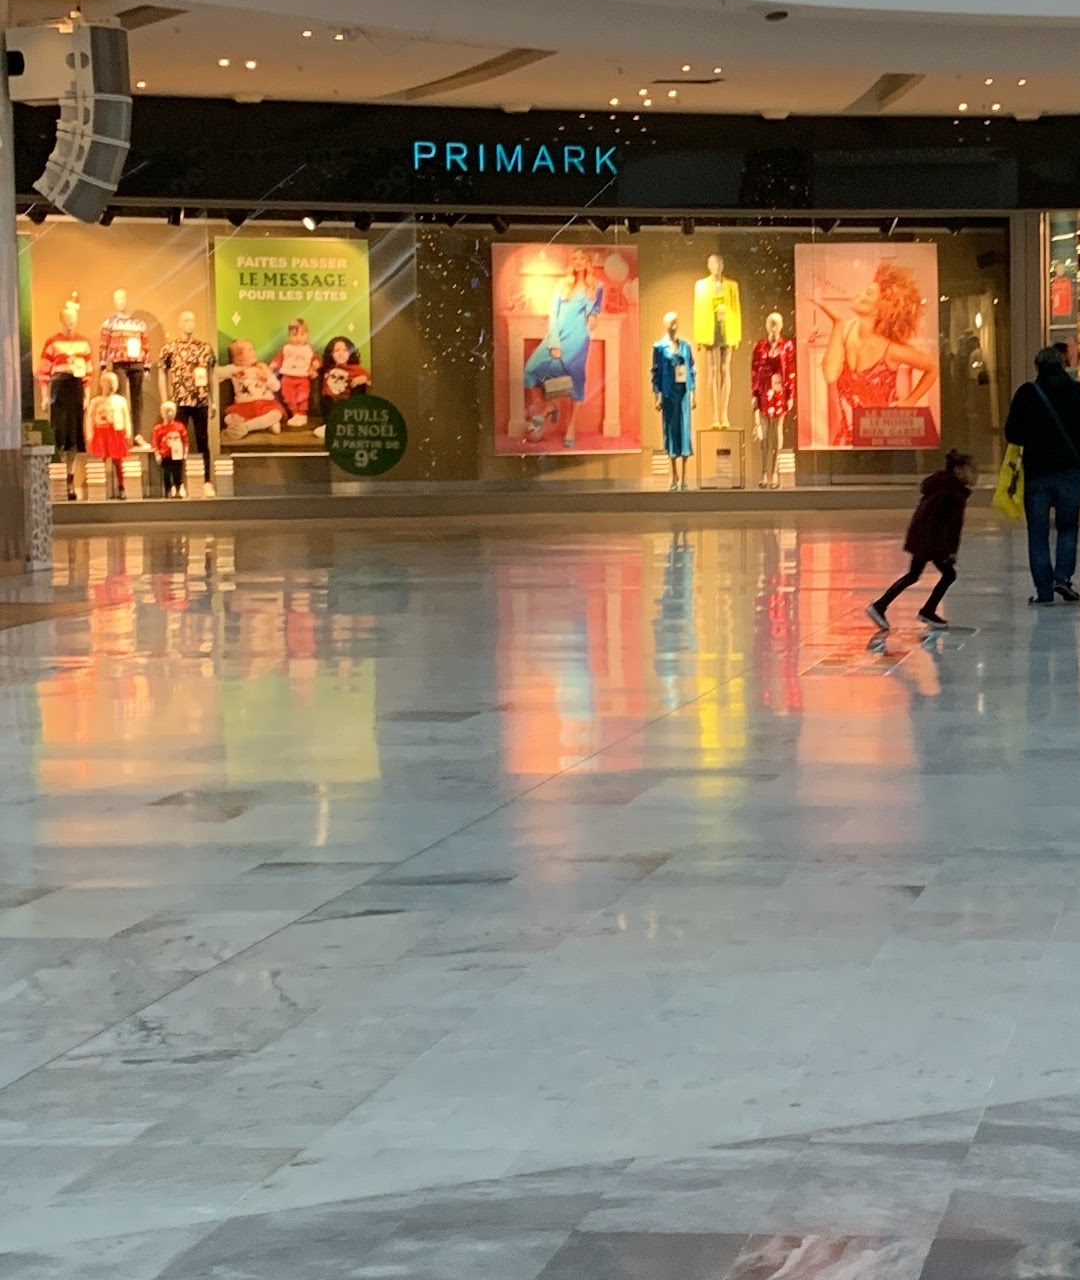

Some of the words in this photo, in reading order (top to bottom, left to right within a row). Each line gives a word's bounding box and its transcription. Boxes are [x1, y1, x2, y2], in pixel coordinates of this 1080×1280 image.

[413, 141, 618, 175] PRIMARK
[237, 256, 287, 268] FAITES
[291, 257, 348, 269] PASSER
[239, 272, 258, 287] LE
[263, 272, 347, 287] MESSAGE
[238, 290, 276, 300] POUR
[279, 290, 303, 301] LES
[306, 289, 347, 301] FÊTES
[343, 408, 389, 422] PULLS
[336, 424, 355, 436] DE
